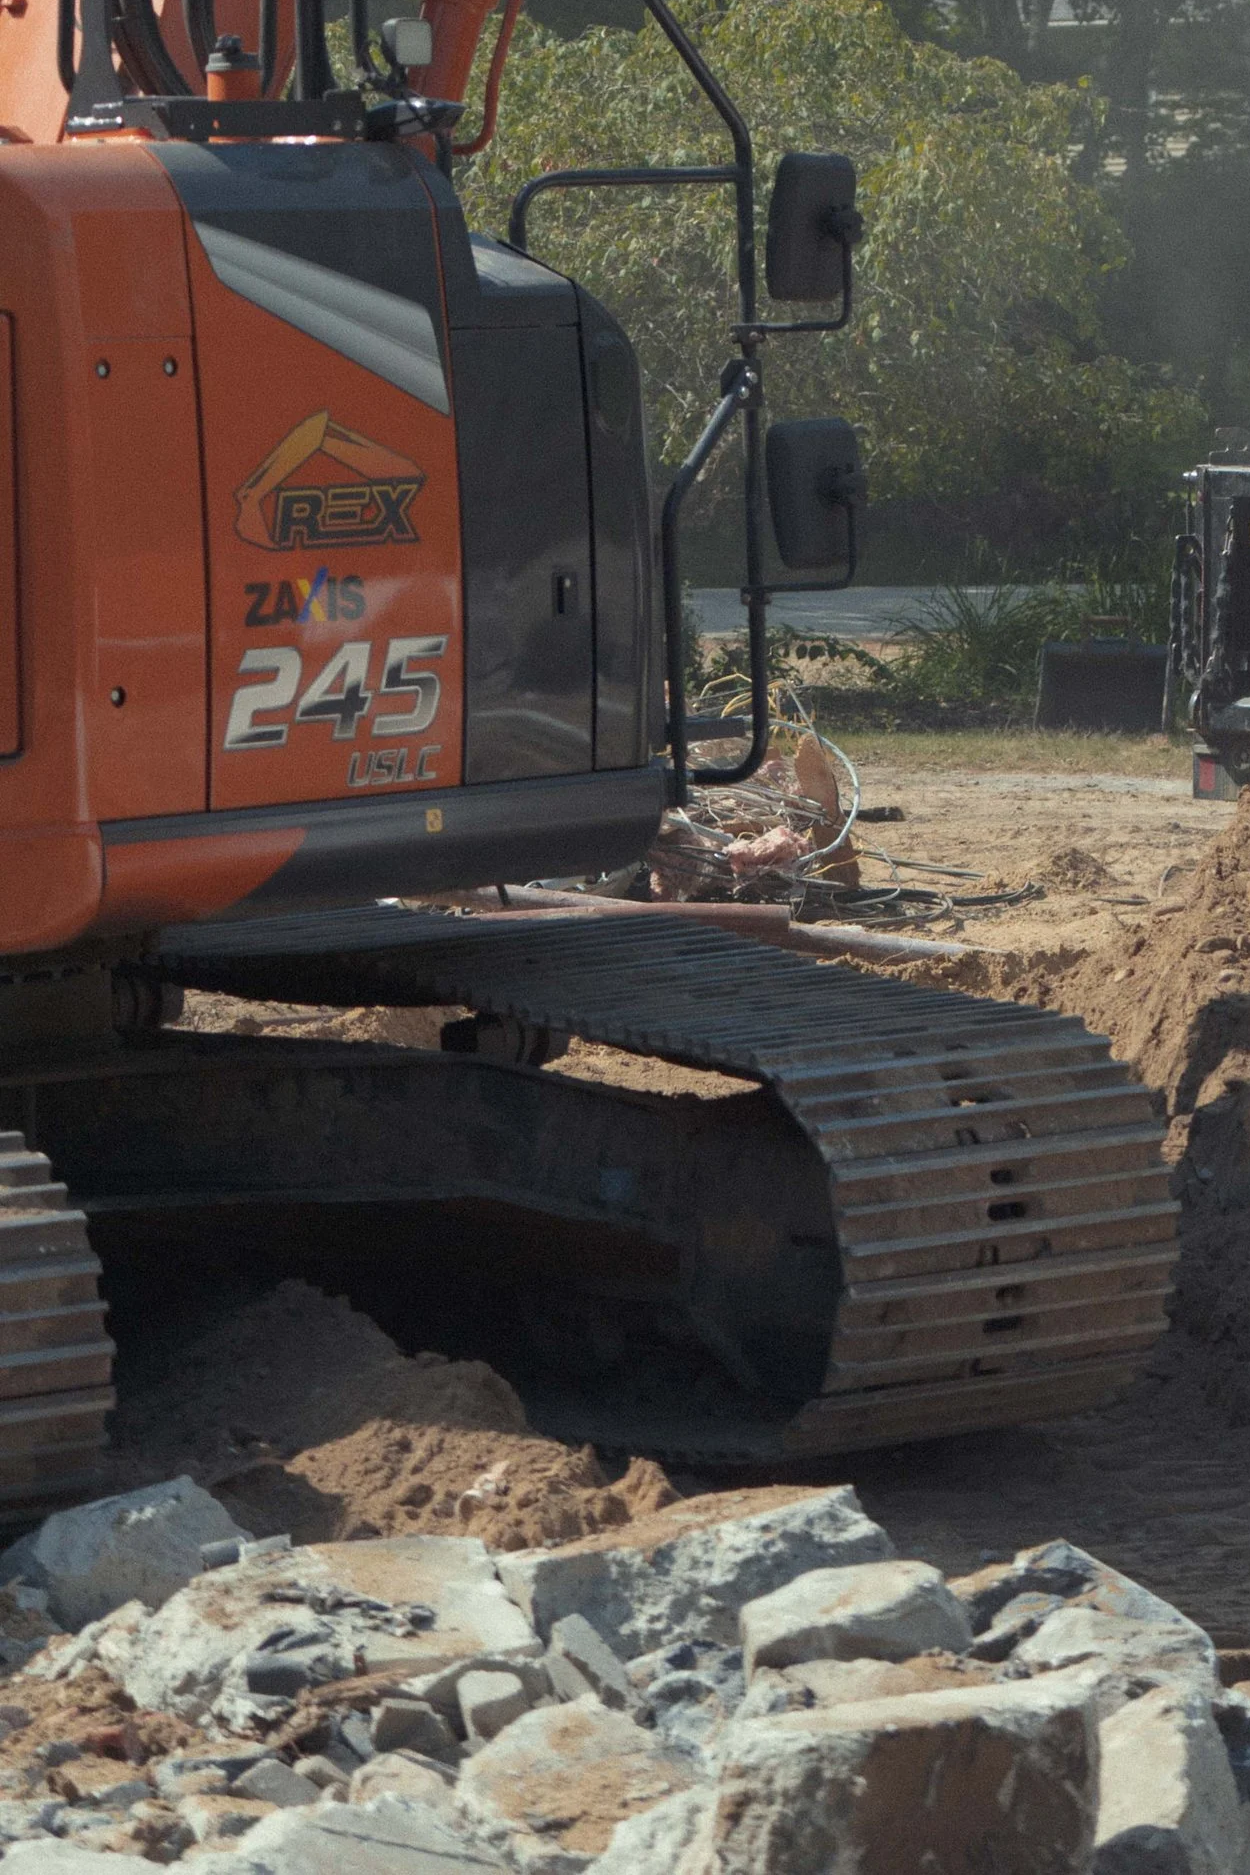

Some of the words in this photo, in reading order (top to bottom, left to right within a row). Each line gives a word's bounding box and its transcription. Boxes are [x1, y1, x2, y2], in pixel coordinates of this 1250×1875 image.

[274, 481, 421, 548] REX
[244, 566, 366, 627] ZAXIS
[223, 634, 449, 752] 245
[347, 745, 442, 787] USLC
